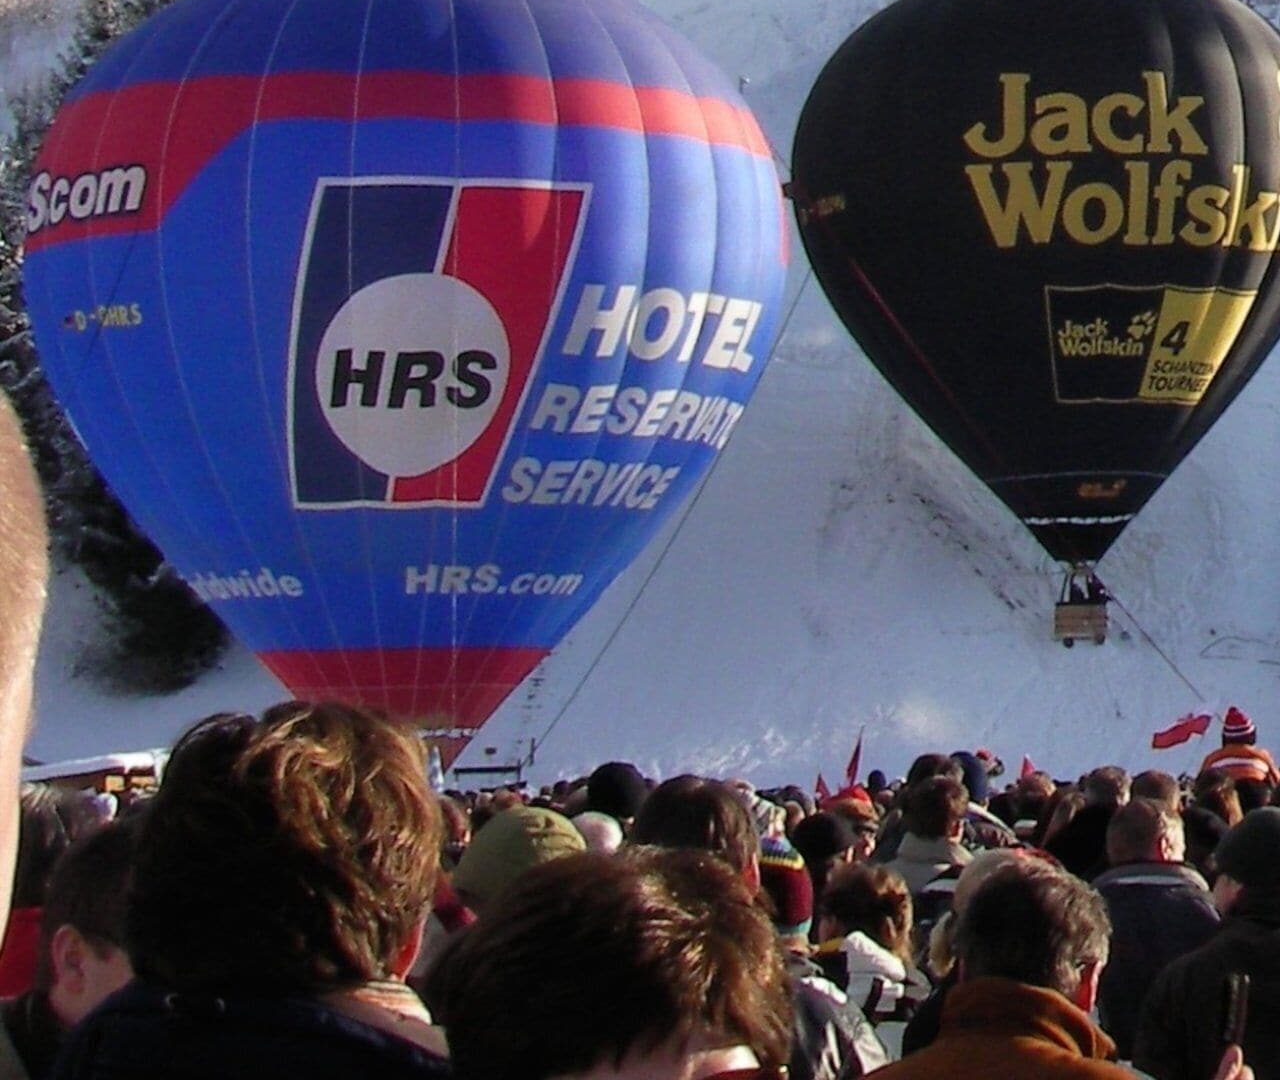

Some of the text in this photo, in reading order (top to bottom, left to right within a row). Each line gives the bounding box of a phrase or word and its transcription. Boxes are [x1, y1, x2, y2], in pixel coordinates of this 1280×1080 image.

[963, 71, 1208, 158] Jack
[562, 283, 763, 373] HOTEL
[1058, 317, 1109, 338] Jack
[1058, 336, 1144, 357] Wolfskin
[1161, 321, 1191, 356] 4
[330, 348, 498, 409] HRS
[502, 456, 681, 510] SERVICE
[405, 563, 585, 595] HRS.com
